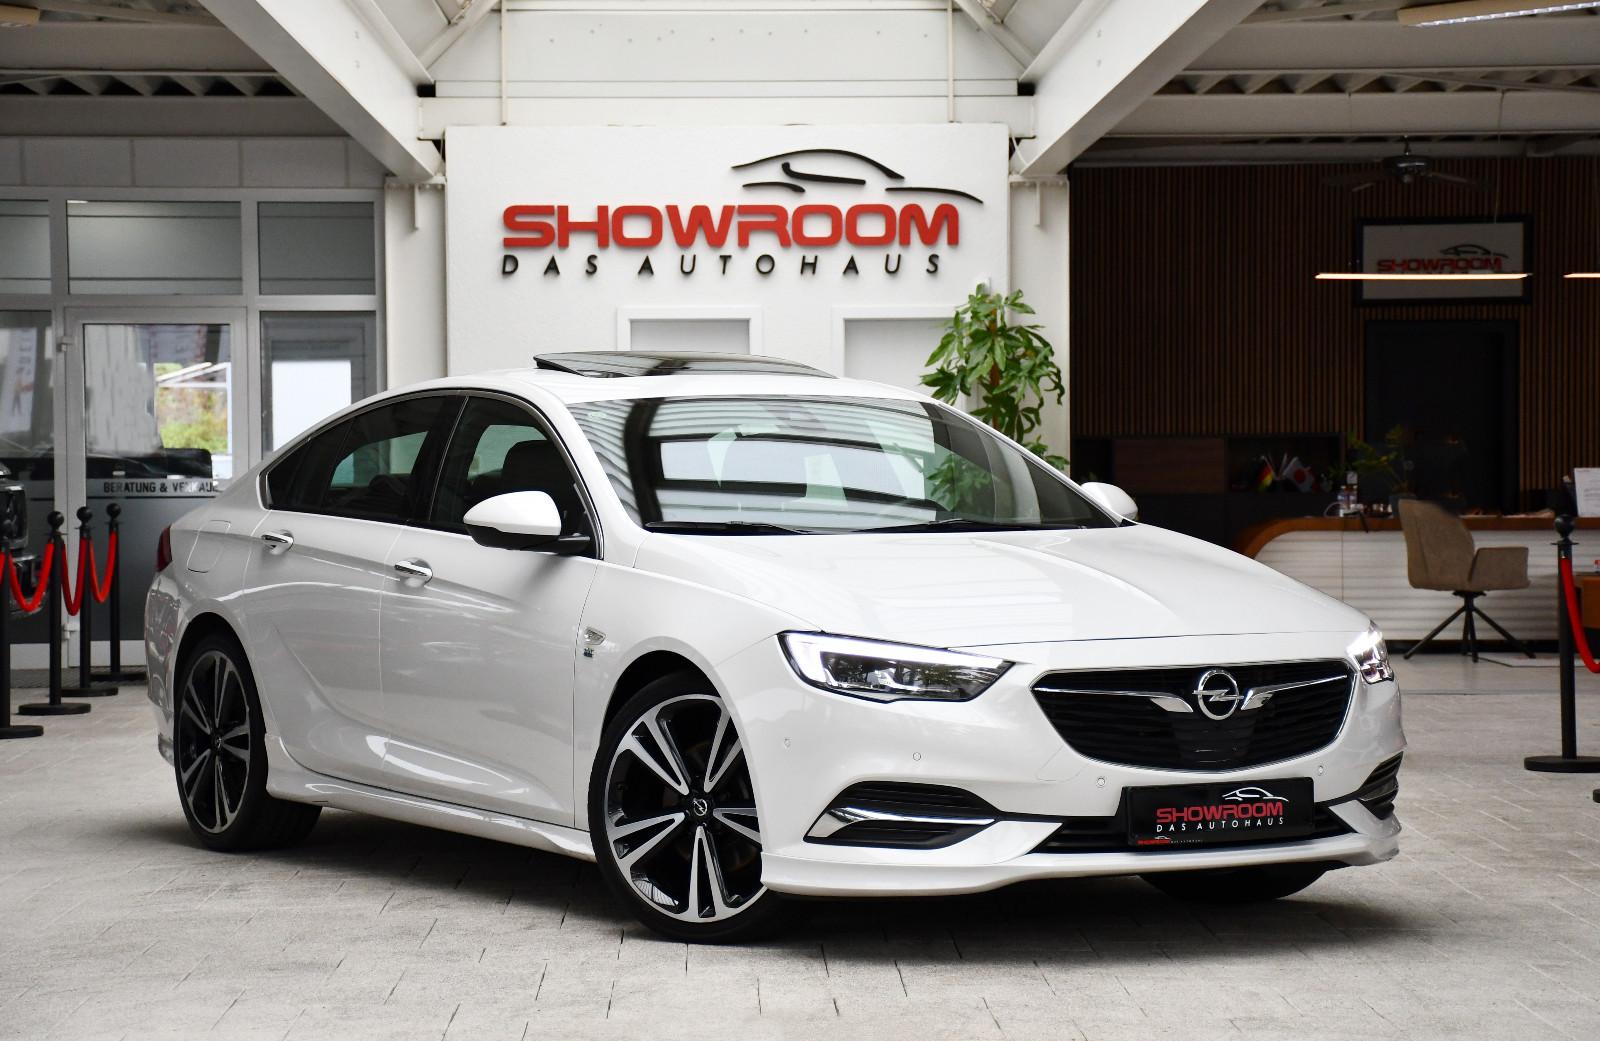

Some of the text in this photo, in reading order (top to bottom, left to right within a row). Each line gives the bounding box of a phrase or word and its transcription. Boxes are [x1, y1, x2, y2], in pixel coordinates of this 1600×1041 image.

[503, 203, 959, 248] SHOWROOM
[502, 253, 940, 276] DAS AUTOHAUS
[1377, 257, 1502, 272] SHOWROOM
[103, 482, 217, 493] BERATUNG & VEKAU
[1156, 801, 1283, 823] SHOWROOM
[1156, 816, 1284, 833] DAS AUTOHAUS
